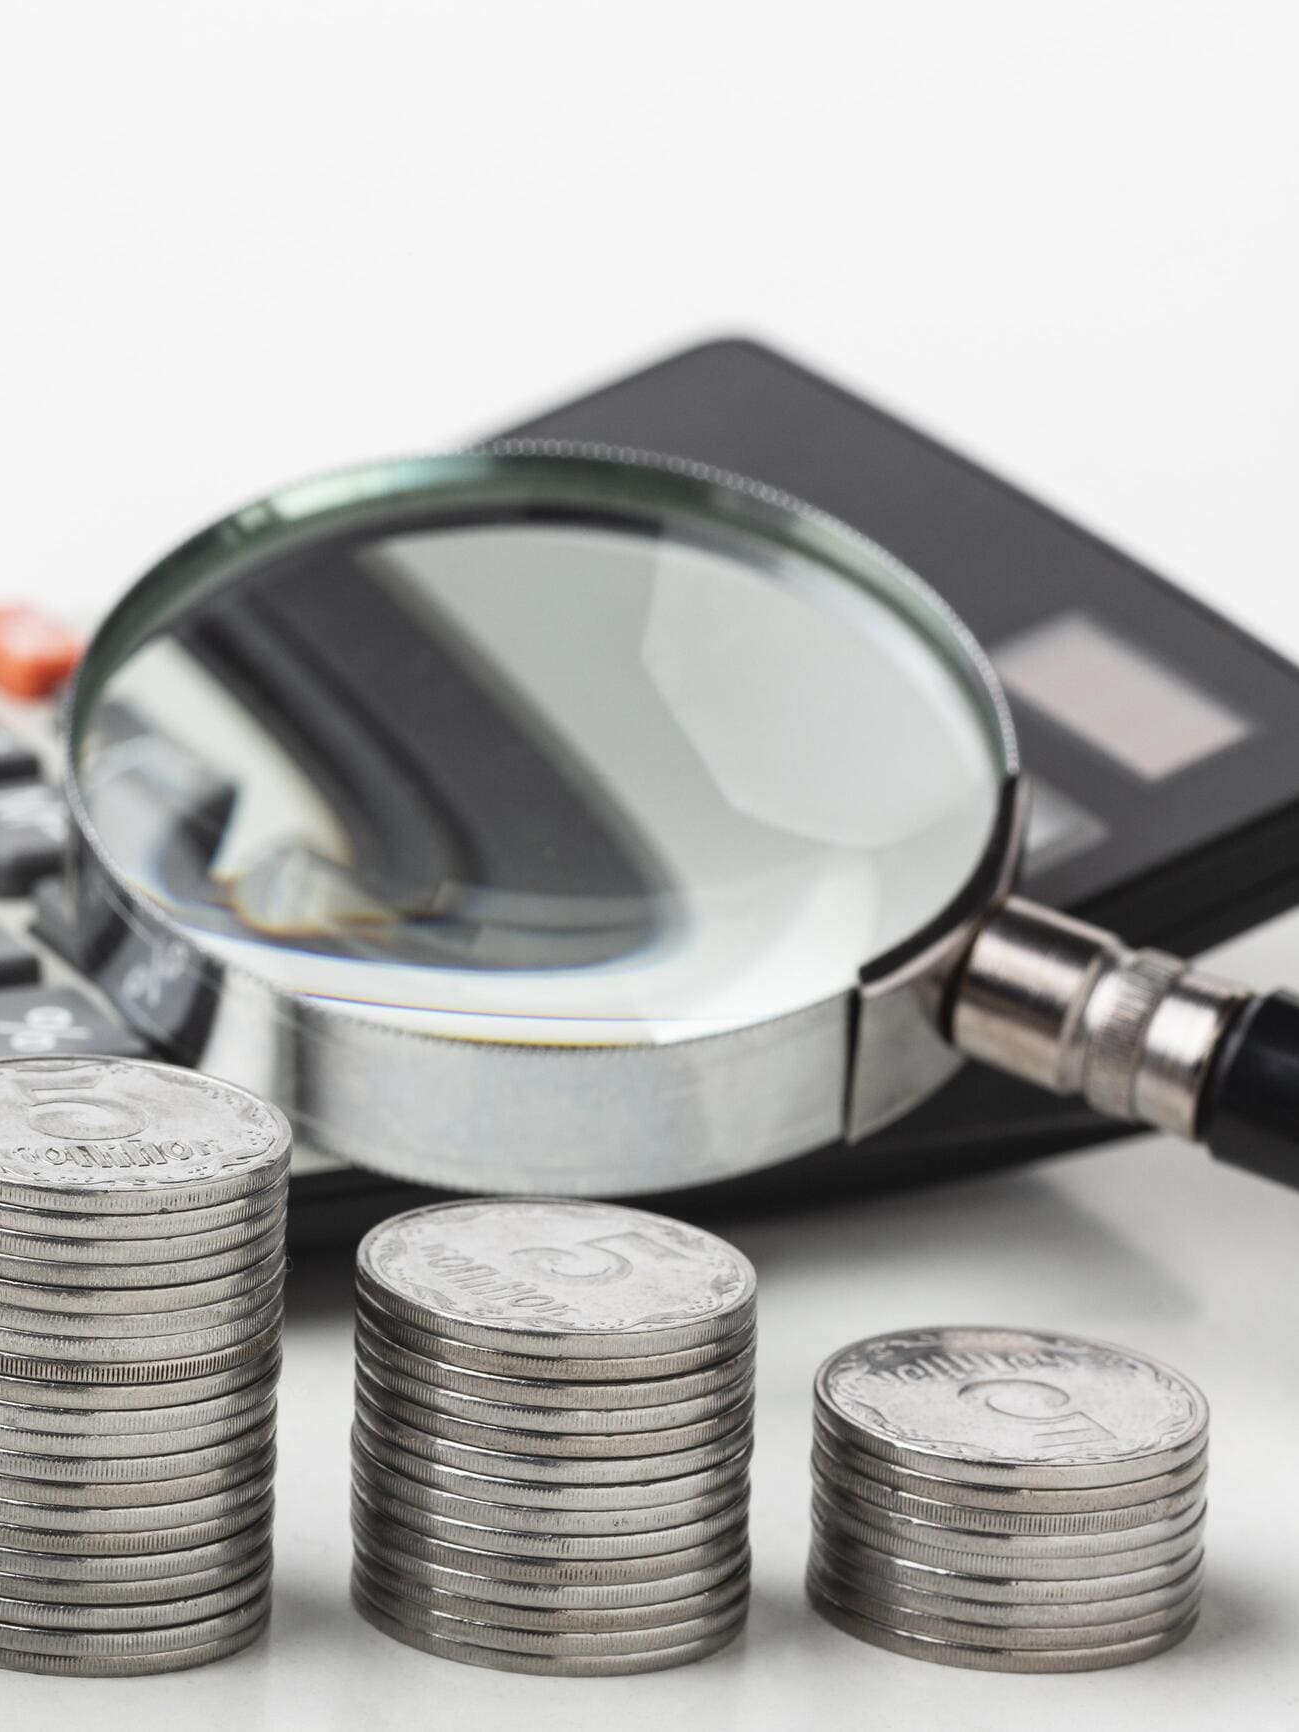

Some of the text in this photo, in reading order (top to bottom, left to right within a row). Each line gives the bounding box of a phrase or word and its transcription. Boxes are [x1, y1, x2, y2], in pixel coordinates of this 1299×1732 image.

[10, 1074, 150, 1141] 5
[510, 1231, 696, 1290] 5
[957, 1379, 1116, 1449] 5
